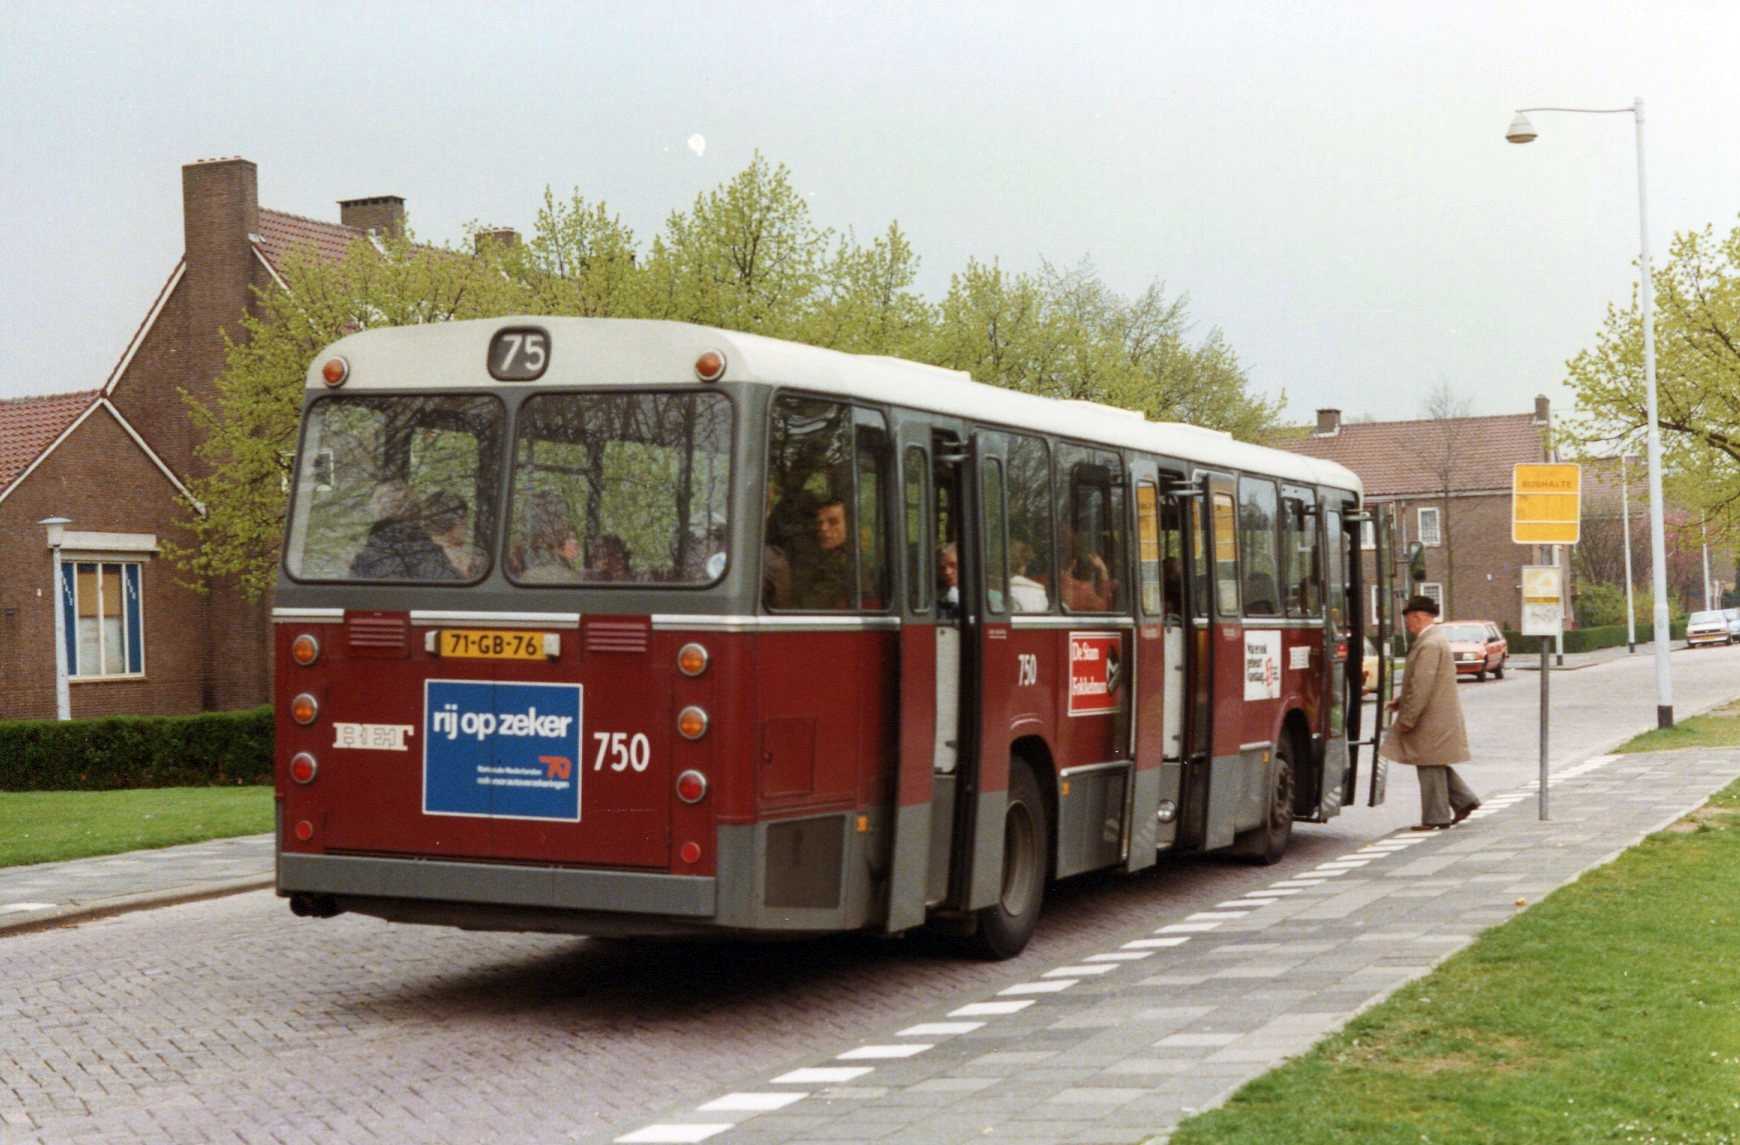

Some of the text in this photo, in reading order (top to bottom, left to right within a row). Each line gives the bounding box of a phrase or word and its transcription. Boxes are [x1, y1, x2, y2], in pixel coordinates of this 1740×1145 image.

[501, 334, 546, 372] 75
[450, 634, 538, 656] 71-GB-76
[1018, 653, 1038, 687] 750
[433, 703, 573, 741] rij op zeker
[593, 731, 651, 772] 750
